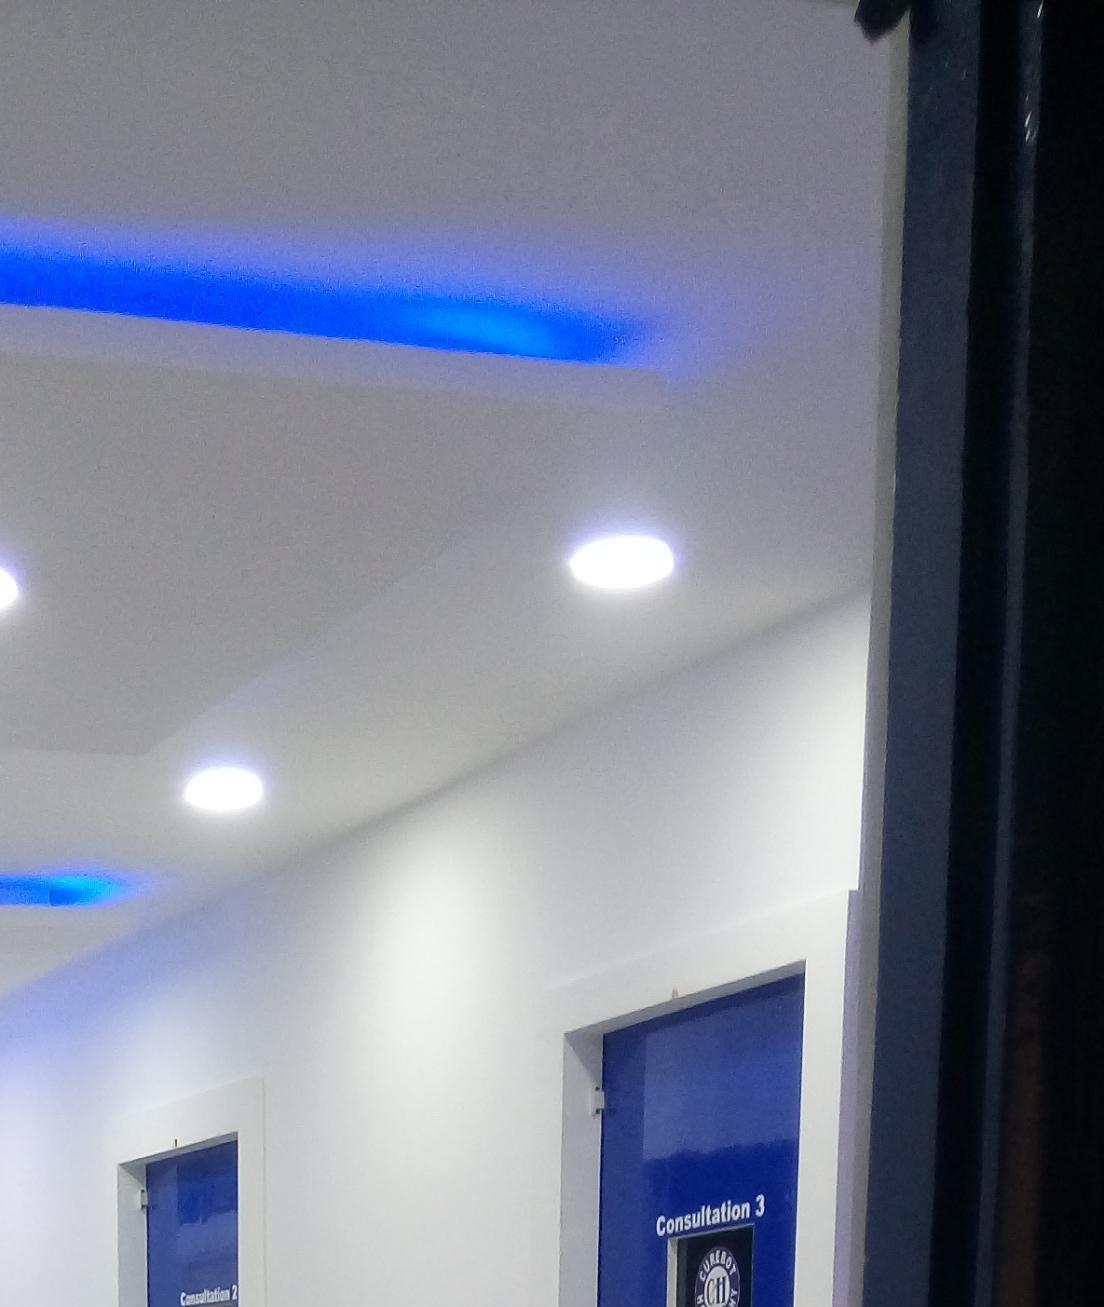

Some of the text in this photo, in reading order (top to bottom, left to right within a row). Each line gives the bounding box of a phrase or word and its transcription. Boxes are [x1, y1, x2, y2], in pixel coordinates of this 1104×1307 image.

[656, 1193, 765, 1237] Consultation 3
[231, 1284, 238, 1300] 2
